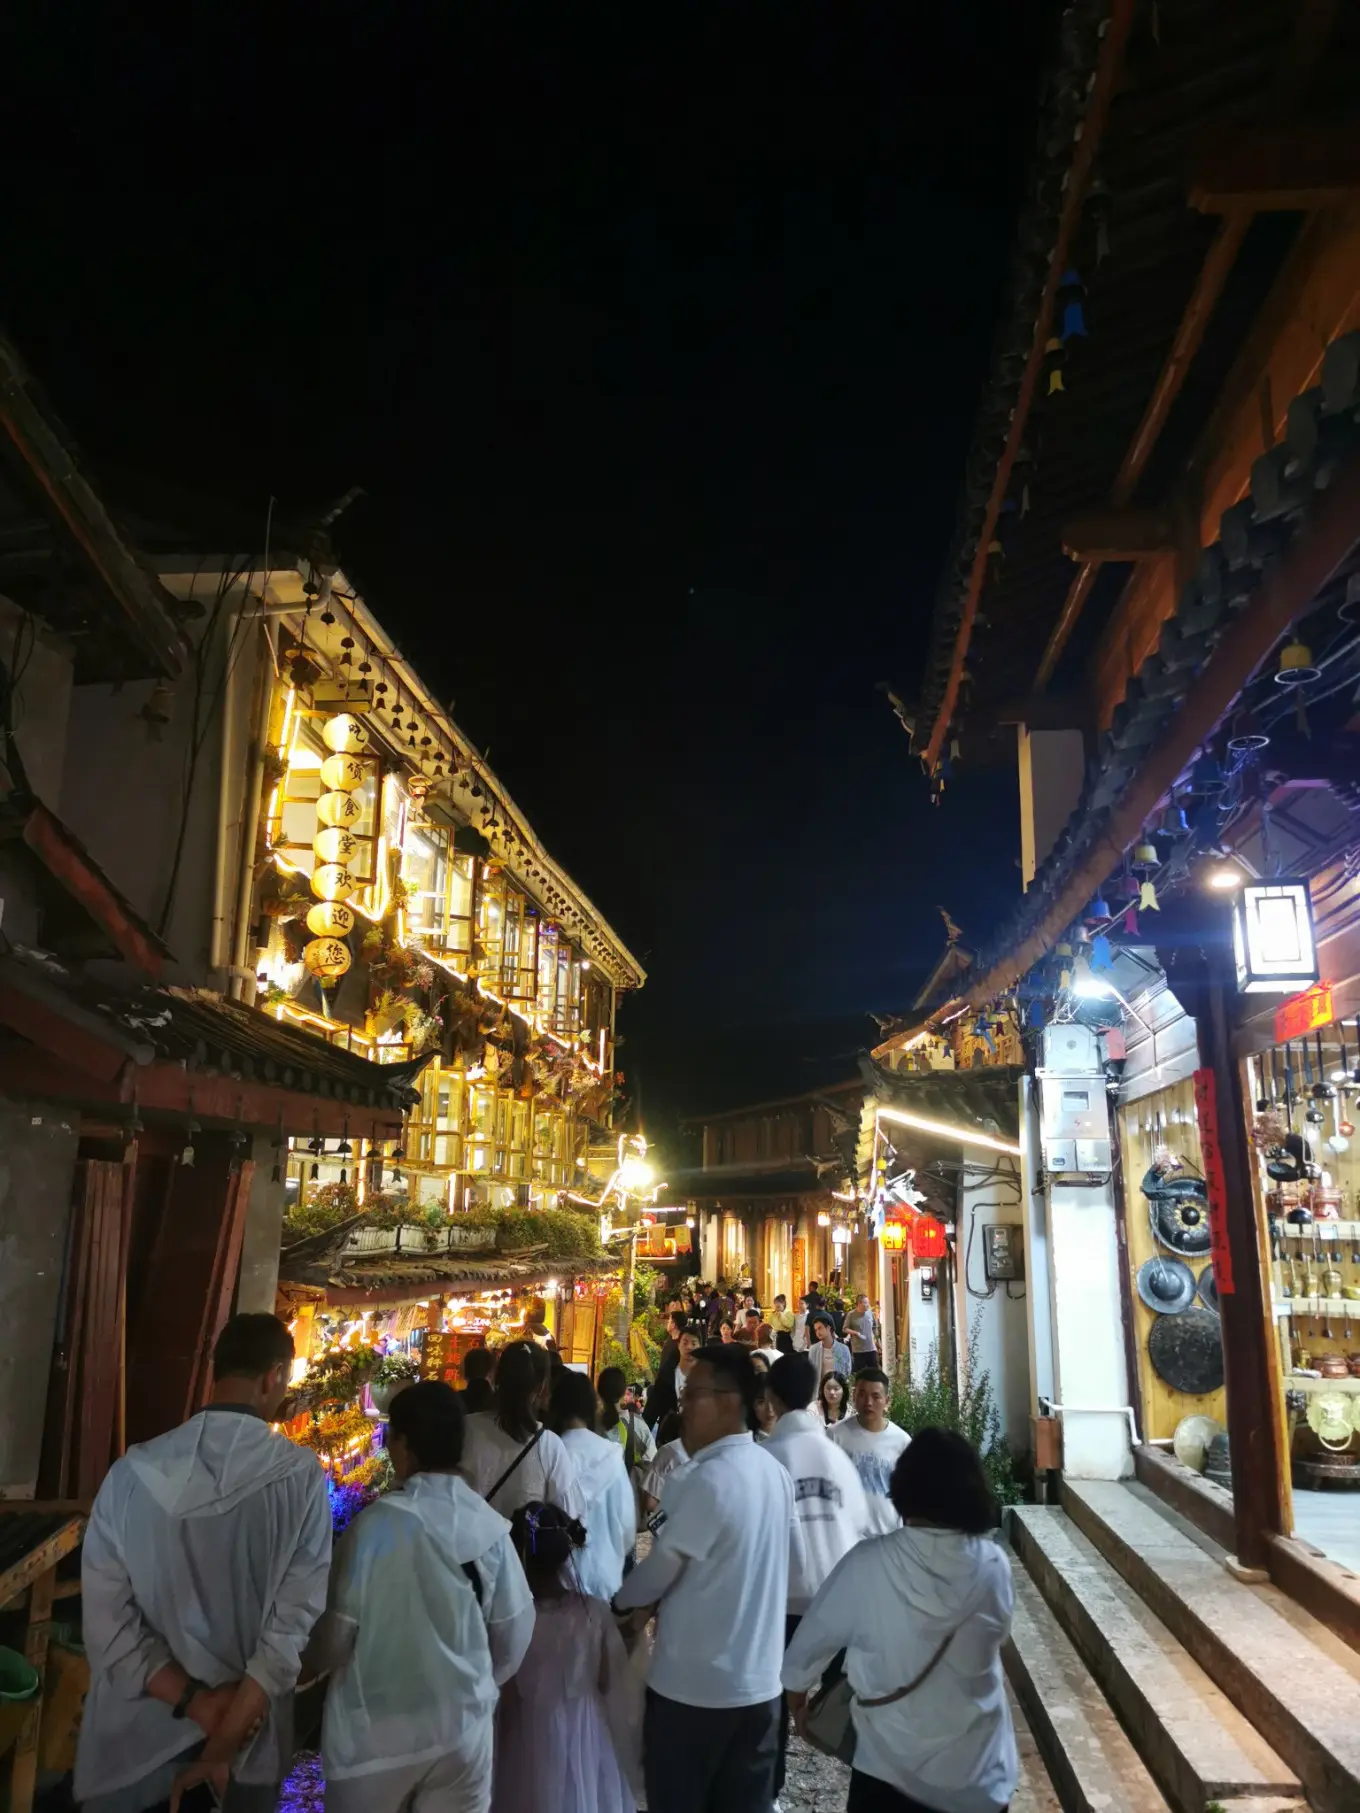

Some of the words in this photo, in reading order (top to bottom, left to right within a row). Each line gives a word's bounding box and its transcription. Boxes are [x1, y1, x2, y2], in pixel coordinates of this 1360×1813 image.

[324, 723, 366, 965] 吃货食堂欢迎您
